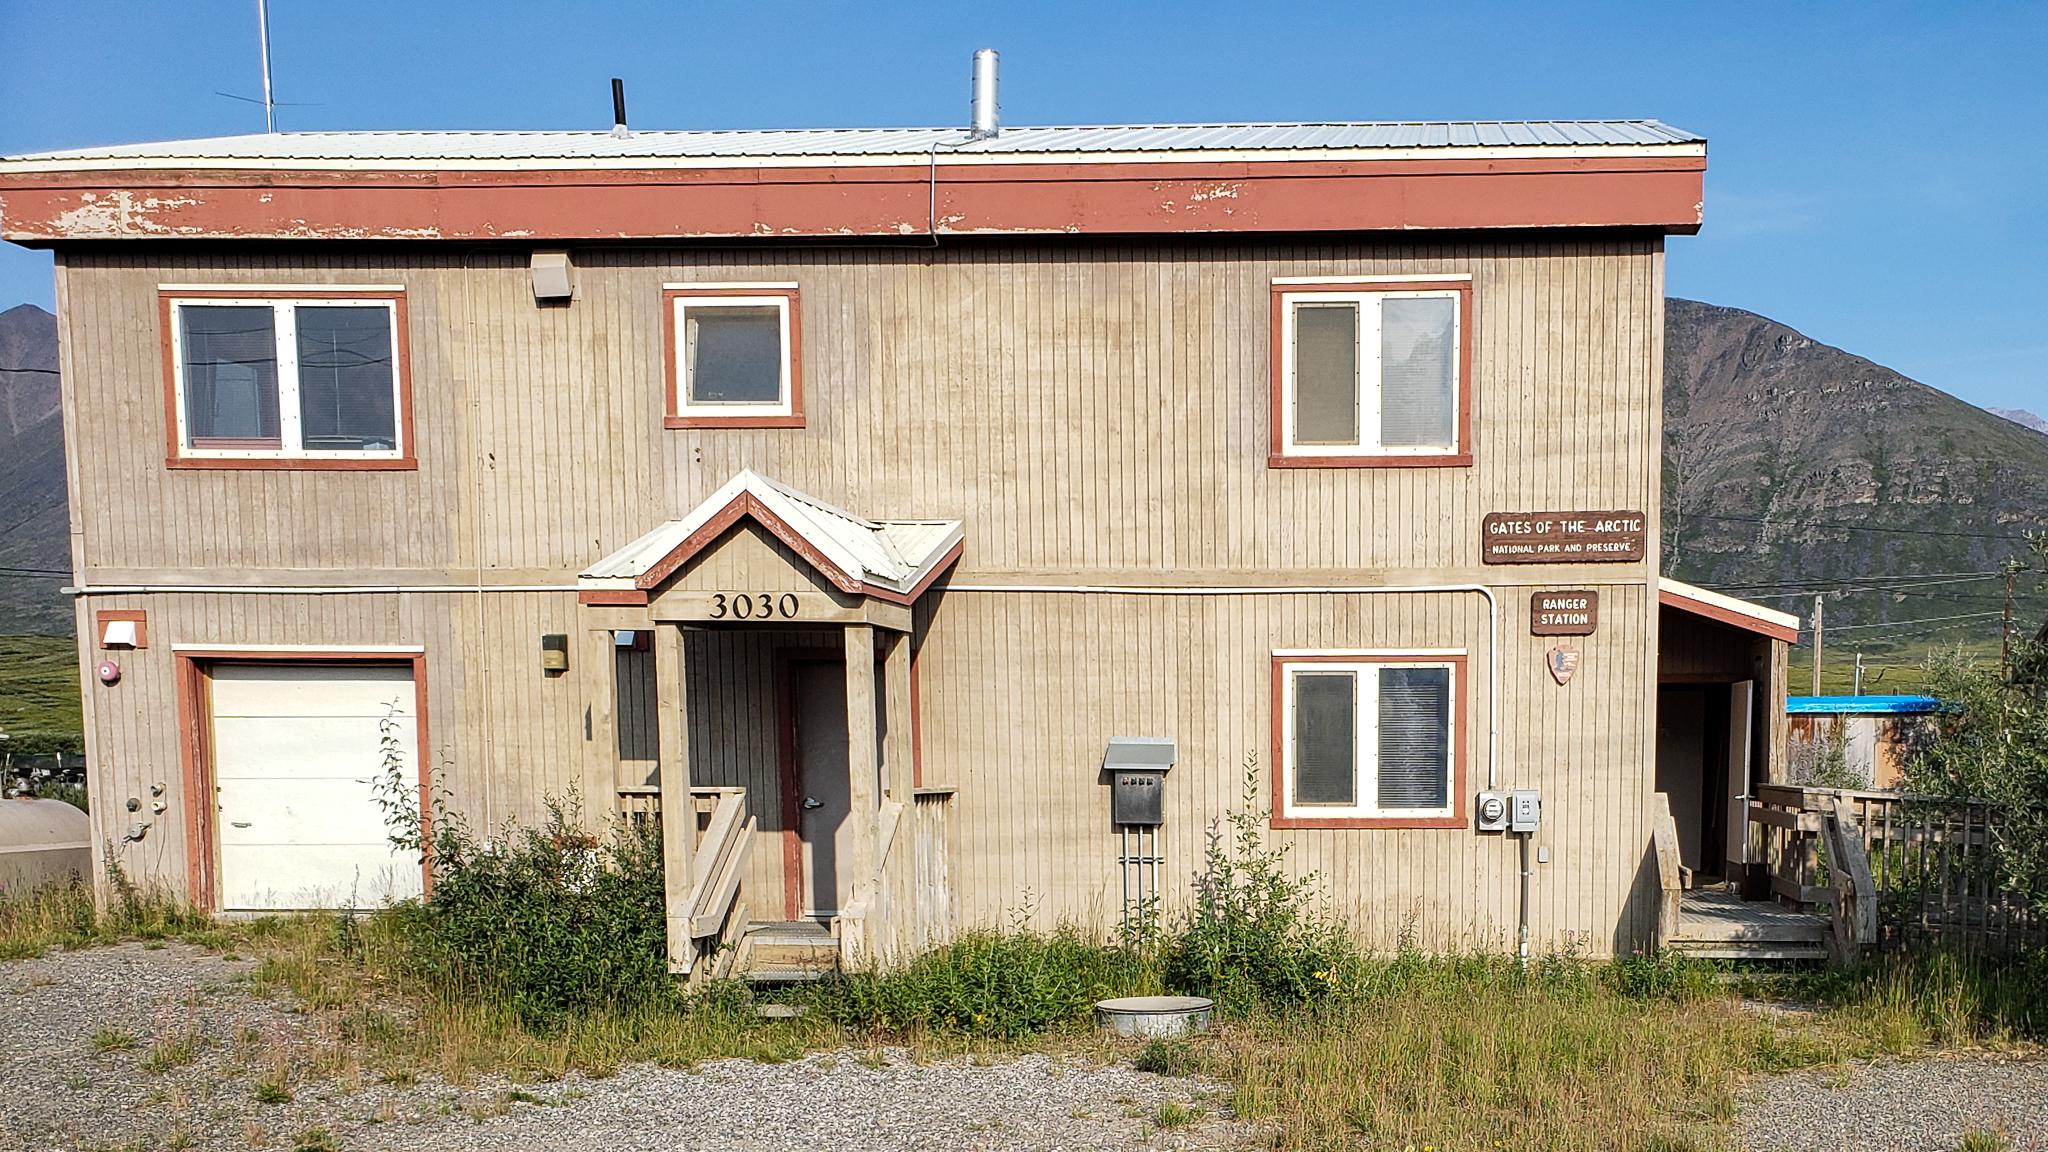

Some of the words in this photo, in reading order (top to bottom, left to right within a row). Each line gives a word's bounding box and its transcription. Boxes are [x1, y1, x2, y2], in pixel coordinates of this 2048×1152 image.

[1490, 521, 1532, 535] GATES
[1535, 521, 1553, 534] OF
[1560, 520, 1585, 533] THE
[1594, 519, 1641, 532] ARCTIC
[1492, 544, 1534, 554] NATIONAL
[1537, 544, 1560, 553] PARK
[1564, 543, 1582, 552] AND
[1586, 542, 1631, 552] PRESERVE
[709, 593, 799, 619] 3030
[1542, 598, 1587, 609] RANGER
[1541, 613, 1588, 625] STATION
